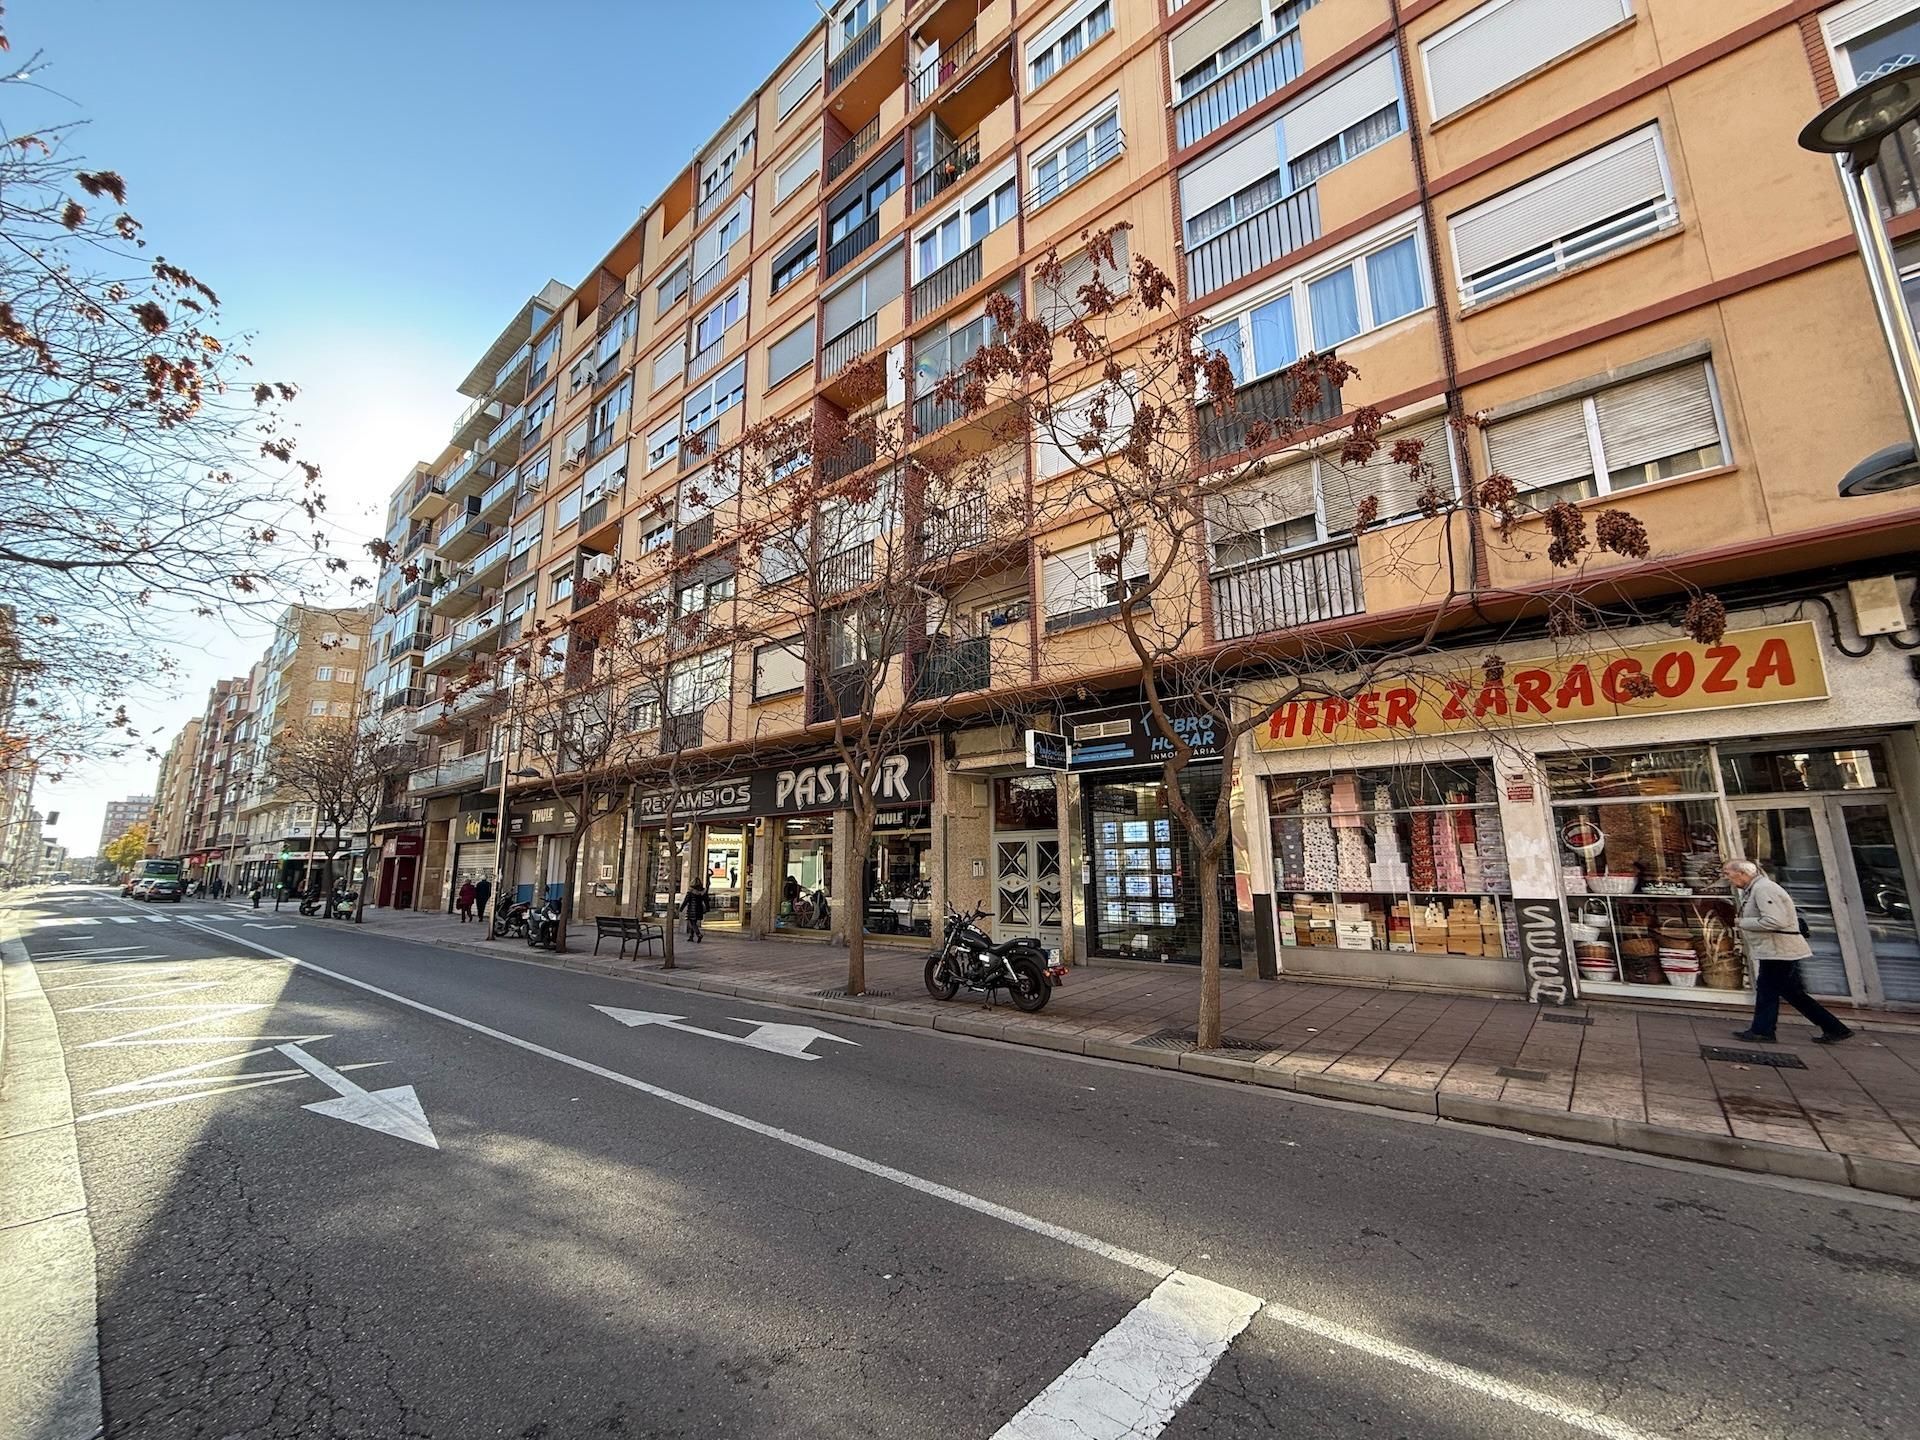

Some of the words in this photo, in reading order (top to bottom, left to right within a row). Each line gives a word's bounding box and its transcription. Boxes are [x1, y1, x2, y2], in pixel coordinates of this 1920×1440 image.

[1270, 687, 1417, 739] HIPER
[1442, 638, 1796, 721] ZARAGOZA
[1167, 714, 1214, 733] BRO
[776, 754, 911, 810] PASTOR
[532, 807, 555, 823] THULE
